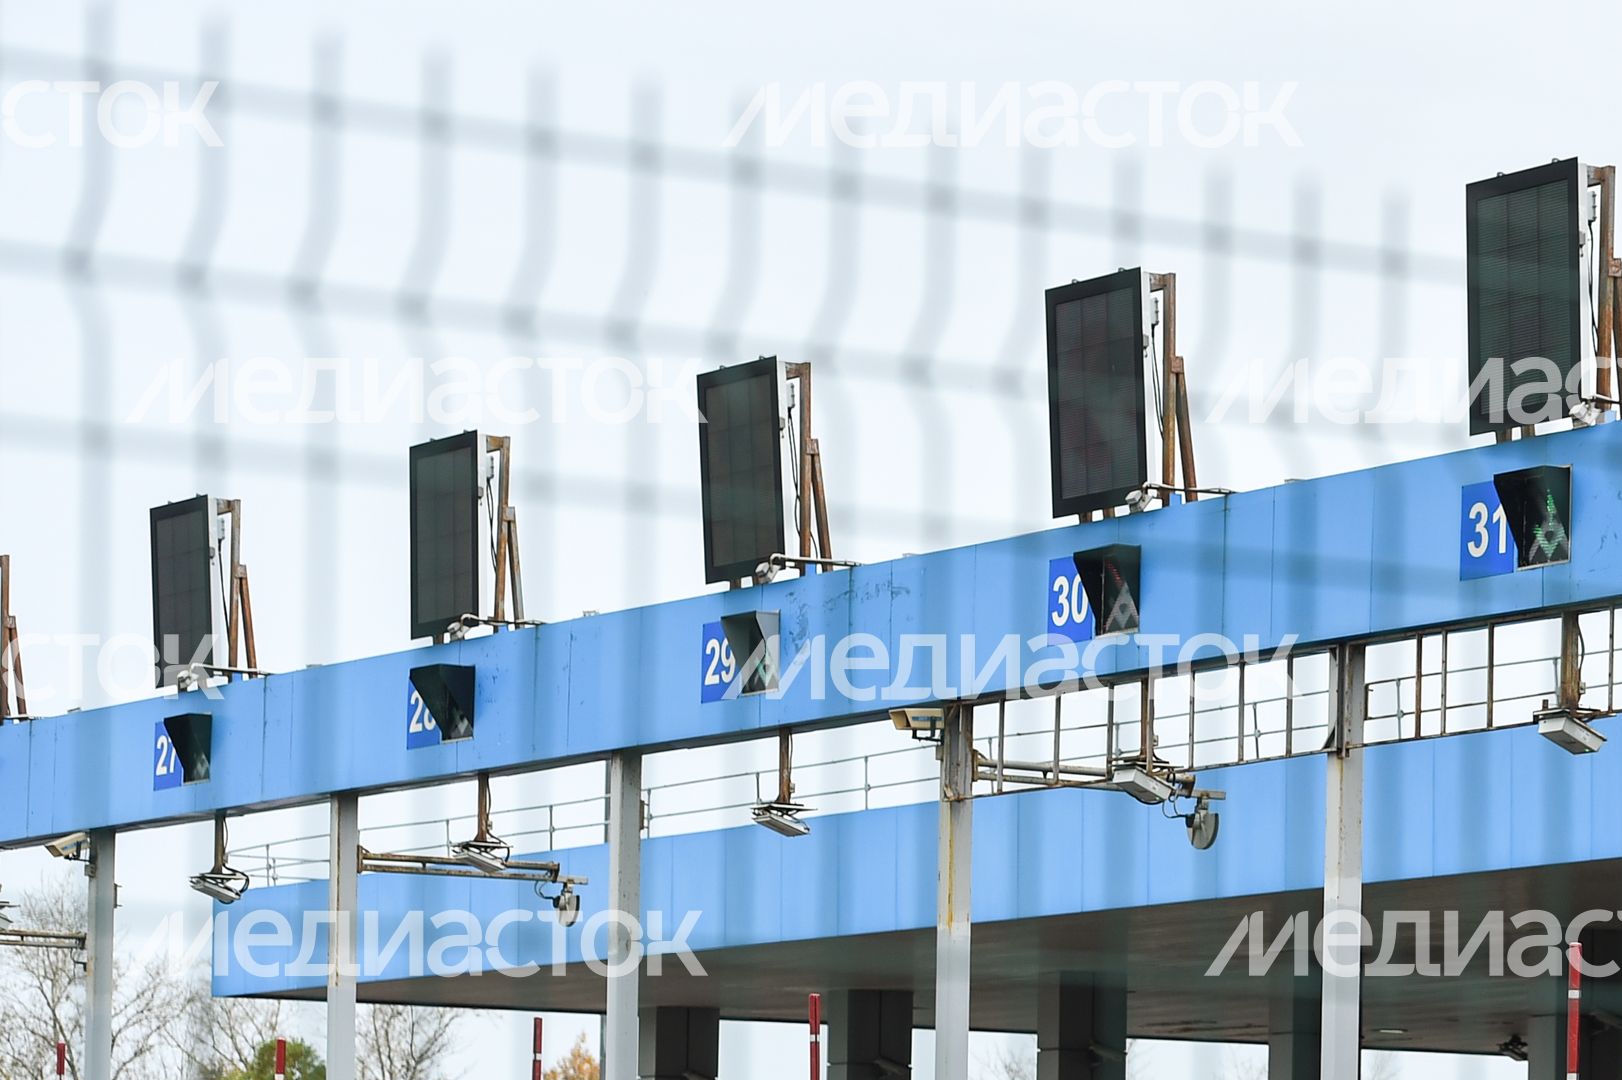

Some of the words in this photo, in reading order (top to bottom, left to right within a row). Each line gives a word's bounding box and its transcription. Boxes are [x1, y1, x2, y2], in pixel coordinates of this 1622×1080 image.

[1467, 501, 1508, 558] 31
[1051, 573, 1090, 627] 30
[704, 638, 737, 687] 29
